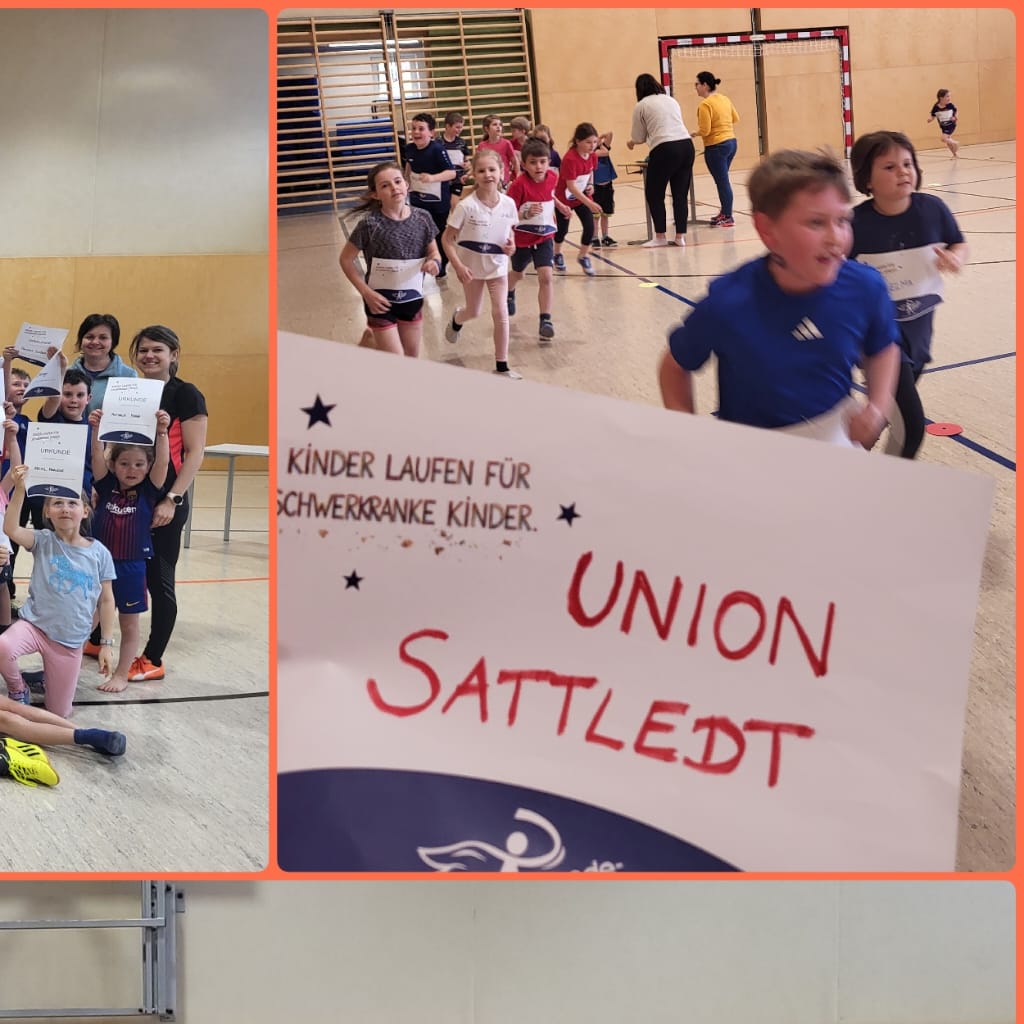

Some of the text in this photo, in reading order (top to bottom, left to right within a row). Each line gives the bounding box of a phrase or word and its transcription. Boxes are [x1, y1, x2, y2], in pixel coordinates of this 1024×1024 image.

[287, 443, 532, 490] KINDER LAUFEN FÜR
[566, 551, 836, 678] UNION
[365, 628, 816, 788] SATTLEDT
